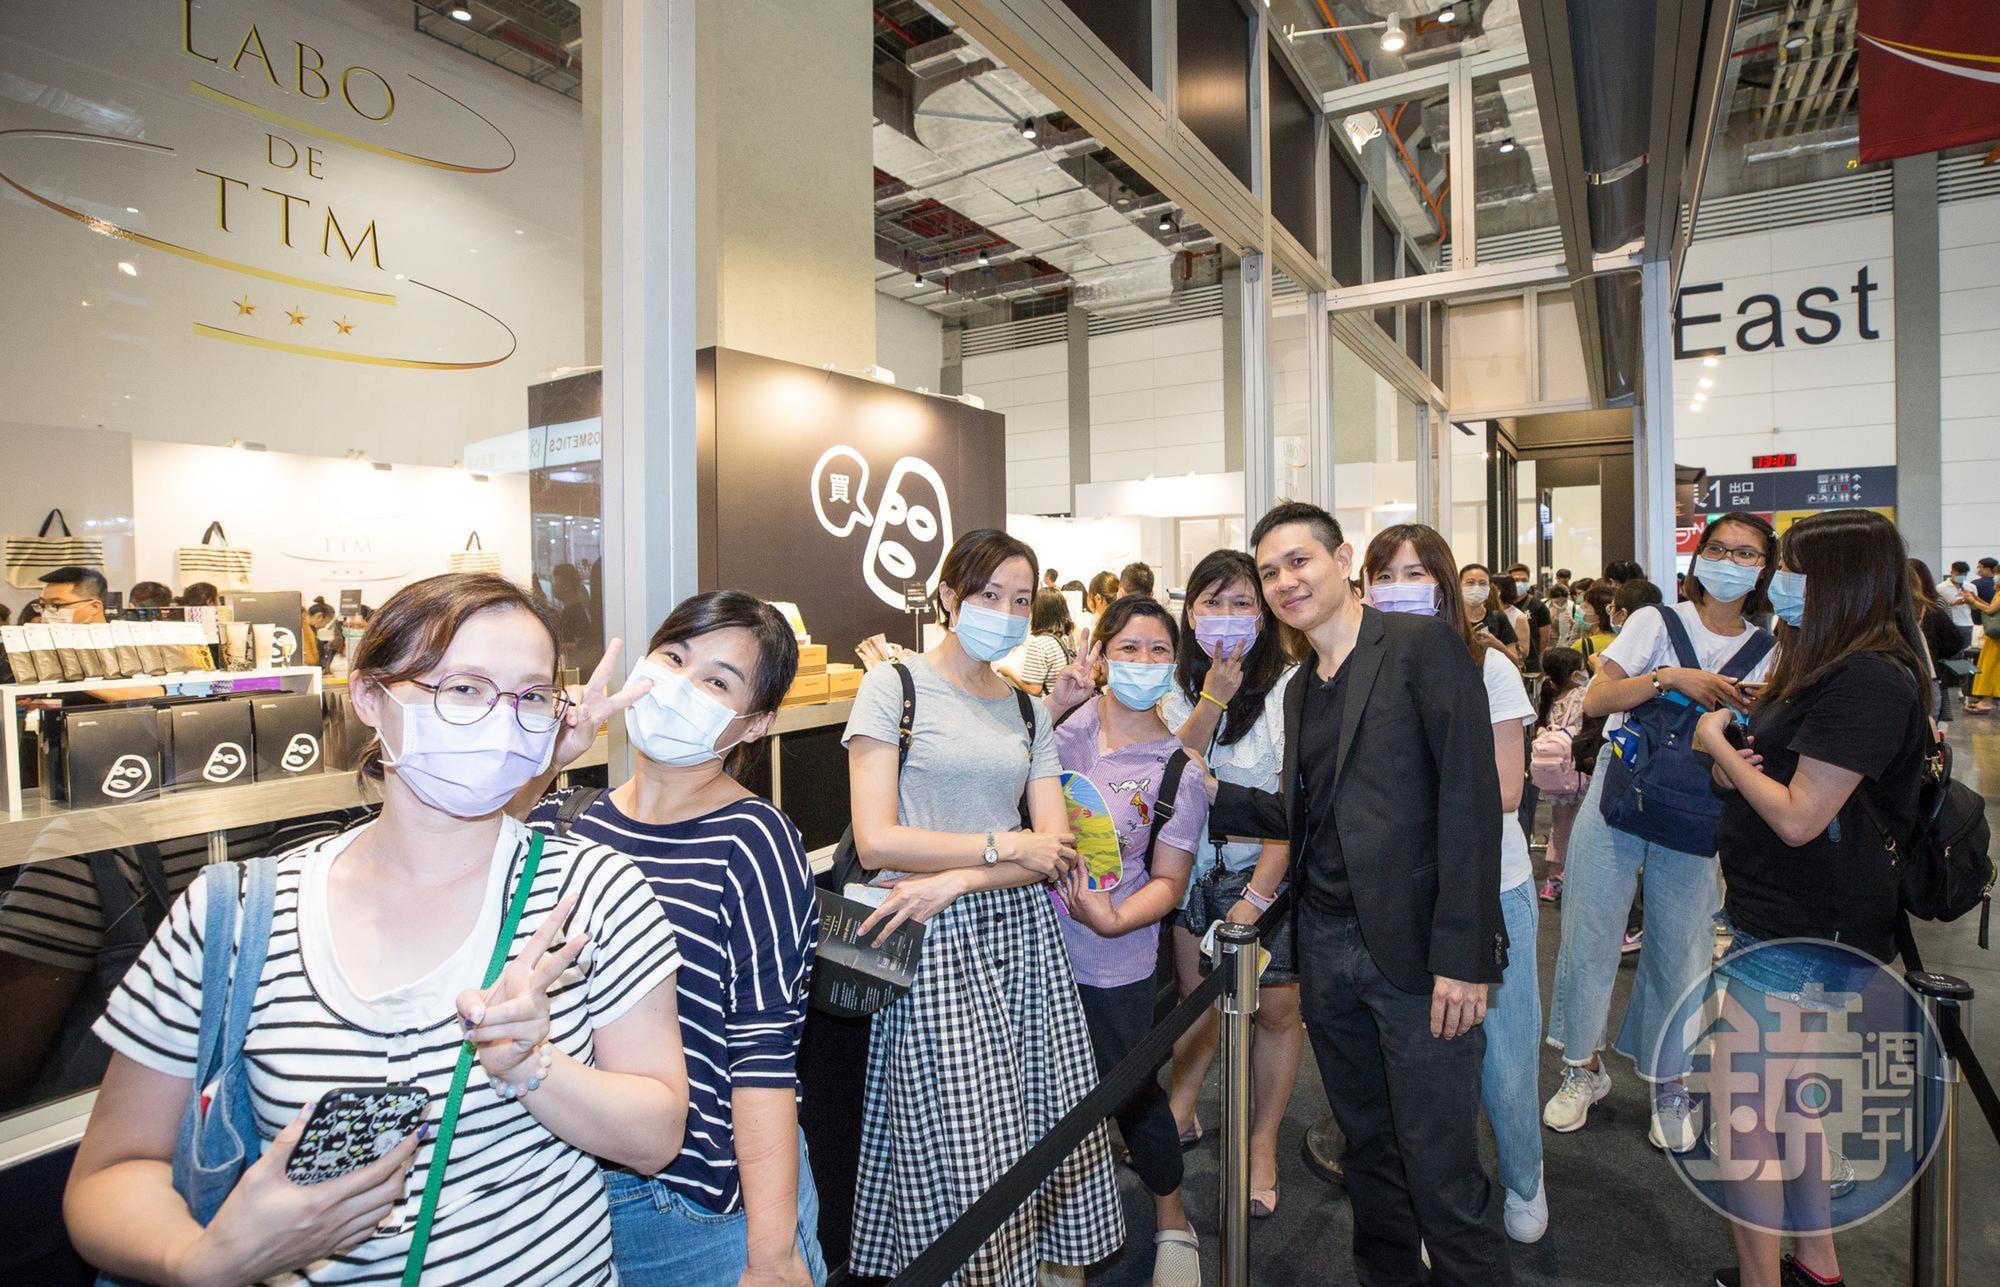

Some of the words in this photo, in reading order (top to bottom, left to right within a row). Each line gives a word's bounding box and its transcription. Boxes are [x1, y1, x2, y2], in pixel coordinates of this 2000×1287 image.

[181, 0, 396, 124] LABO
[264, 132, 325, 181] DE
[195, 168, 387, 271] TTM
[1673, 265, 1880, 361] East
[829, 473, 850, 504] 買
[1729, 482, 1755, 494] 出口
[1732, 495, 1751, 506] Exit
[320, 536, 374, 553] TTM
